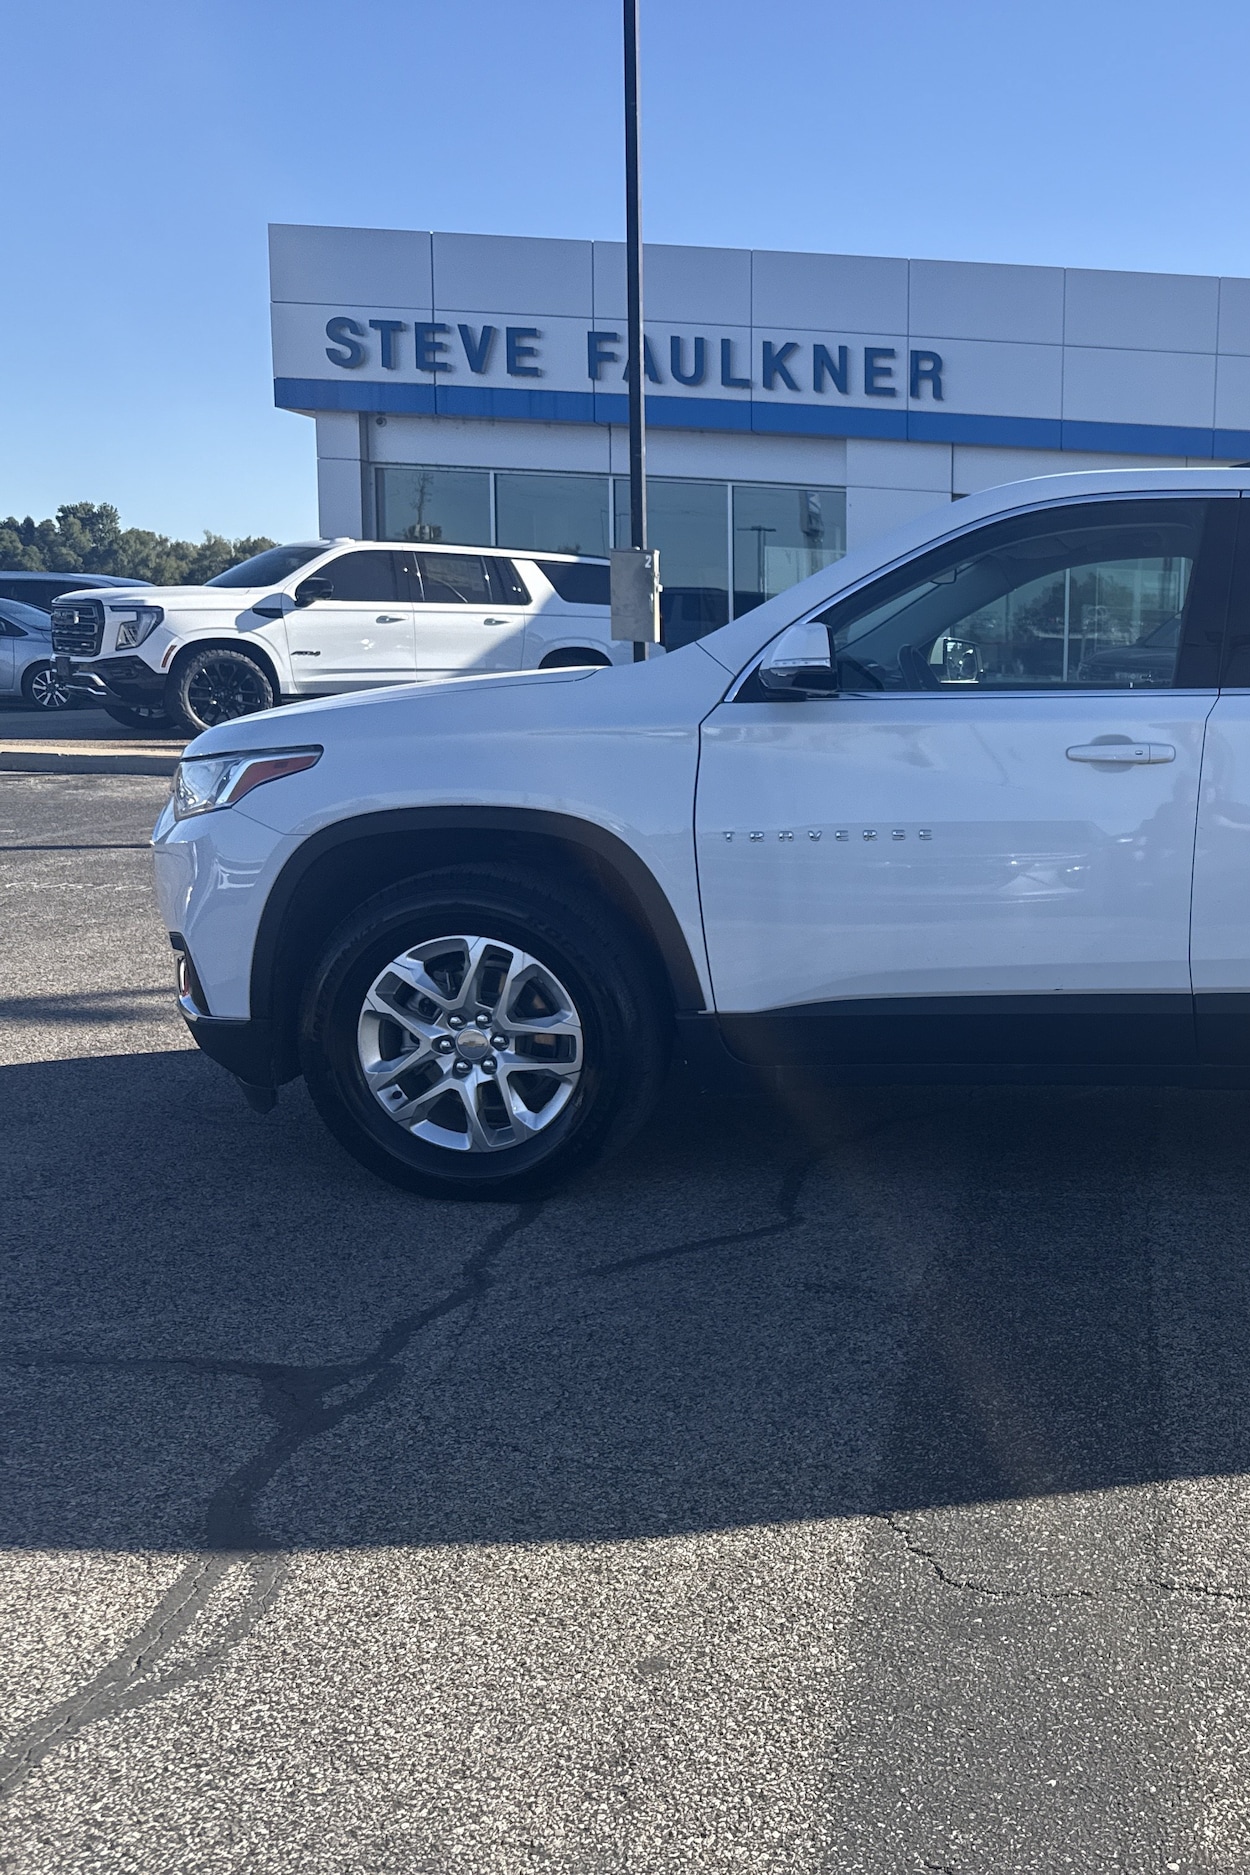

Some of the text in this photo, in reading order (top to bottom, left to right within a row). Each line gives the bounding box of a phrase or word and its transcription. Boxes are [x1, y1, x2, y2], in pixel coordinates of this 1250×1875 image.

[325, 316, 945, 400] STEVE FAULKNER
[645, 555, 652, 569] 2
[723, 830, 933, 843] TRAVERSE
